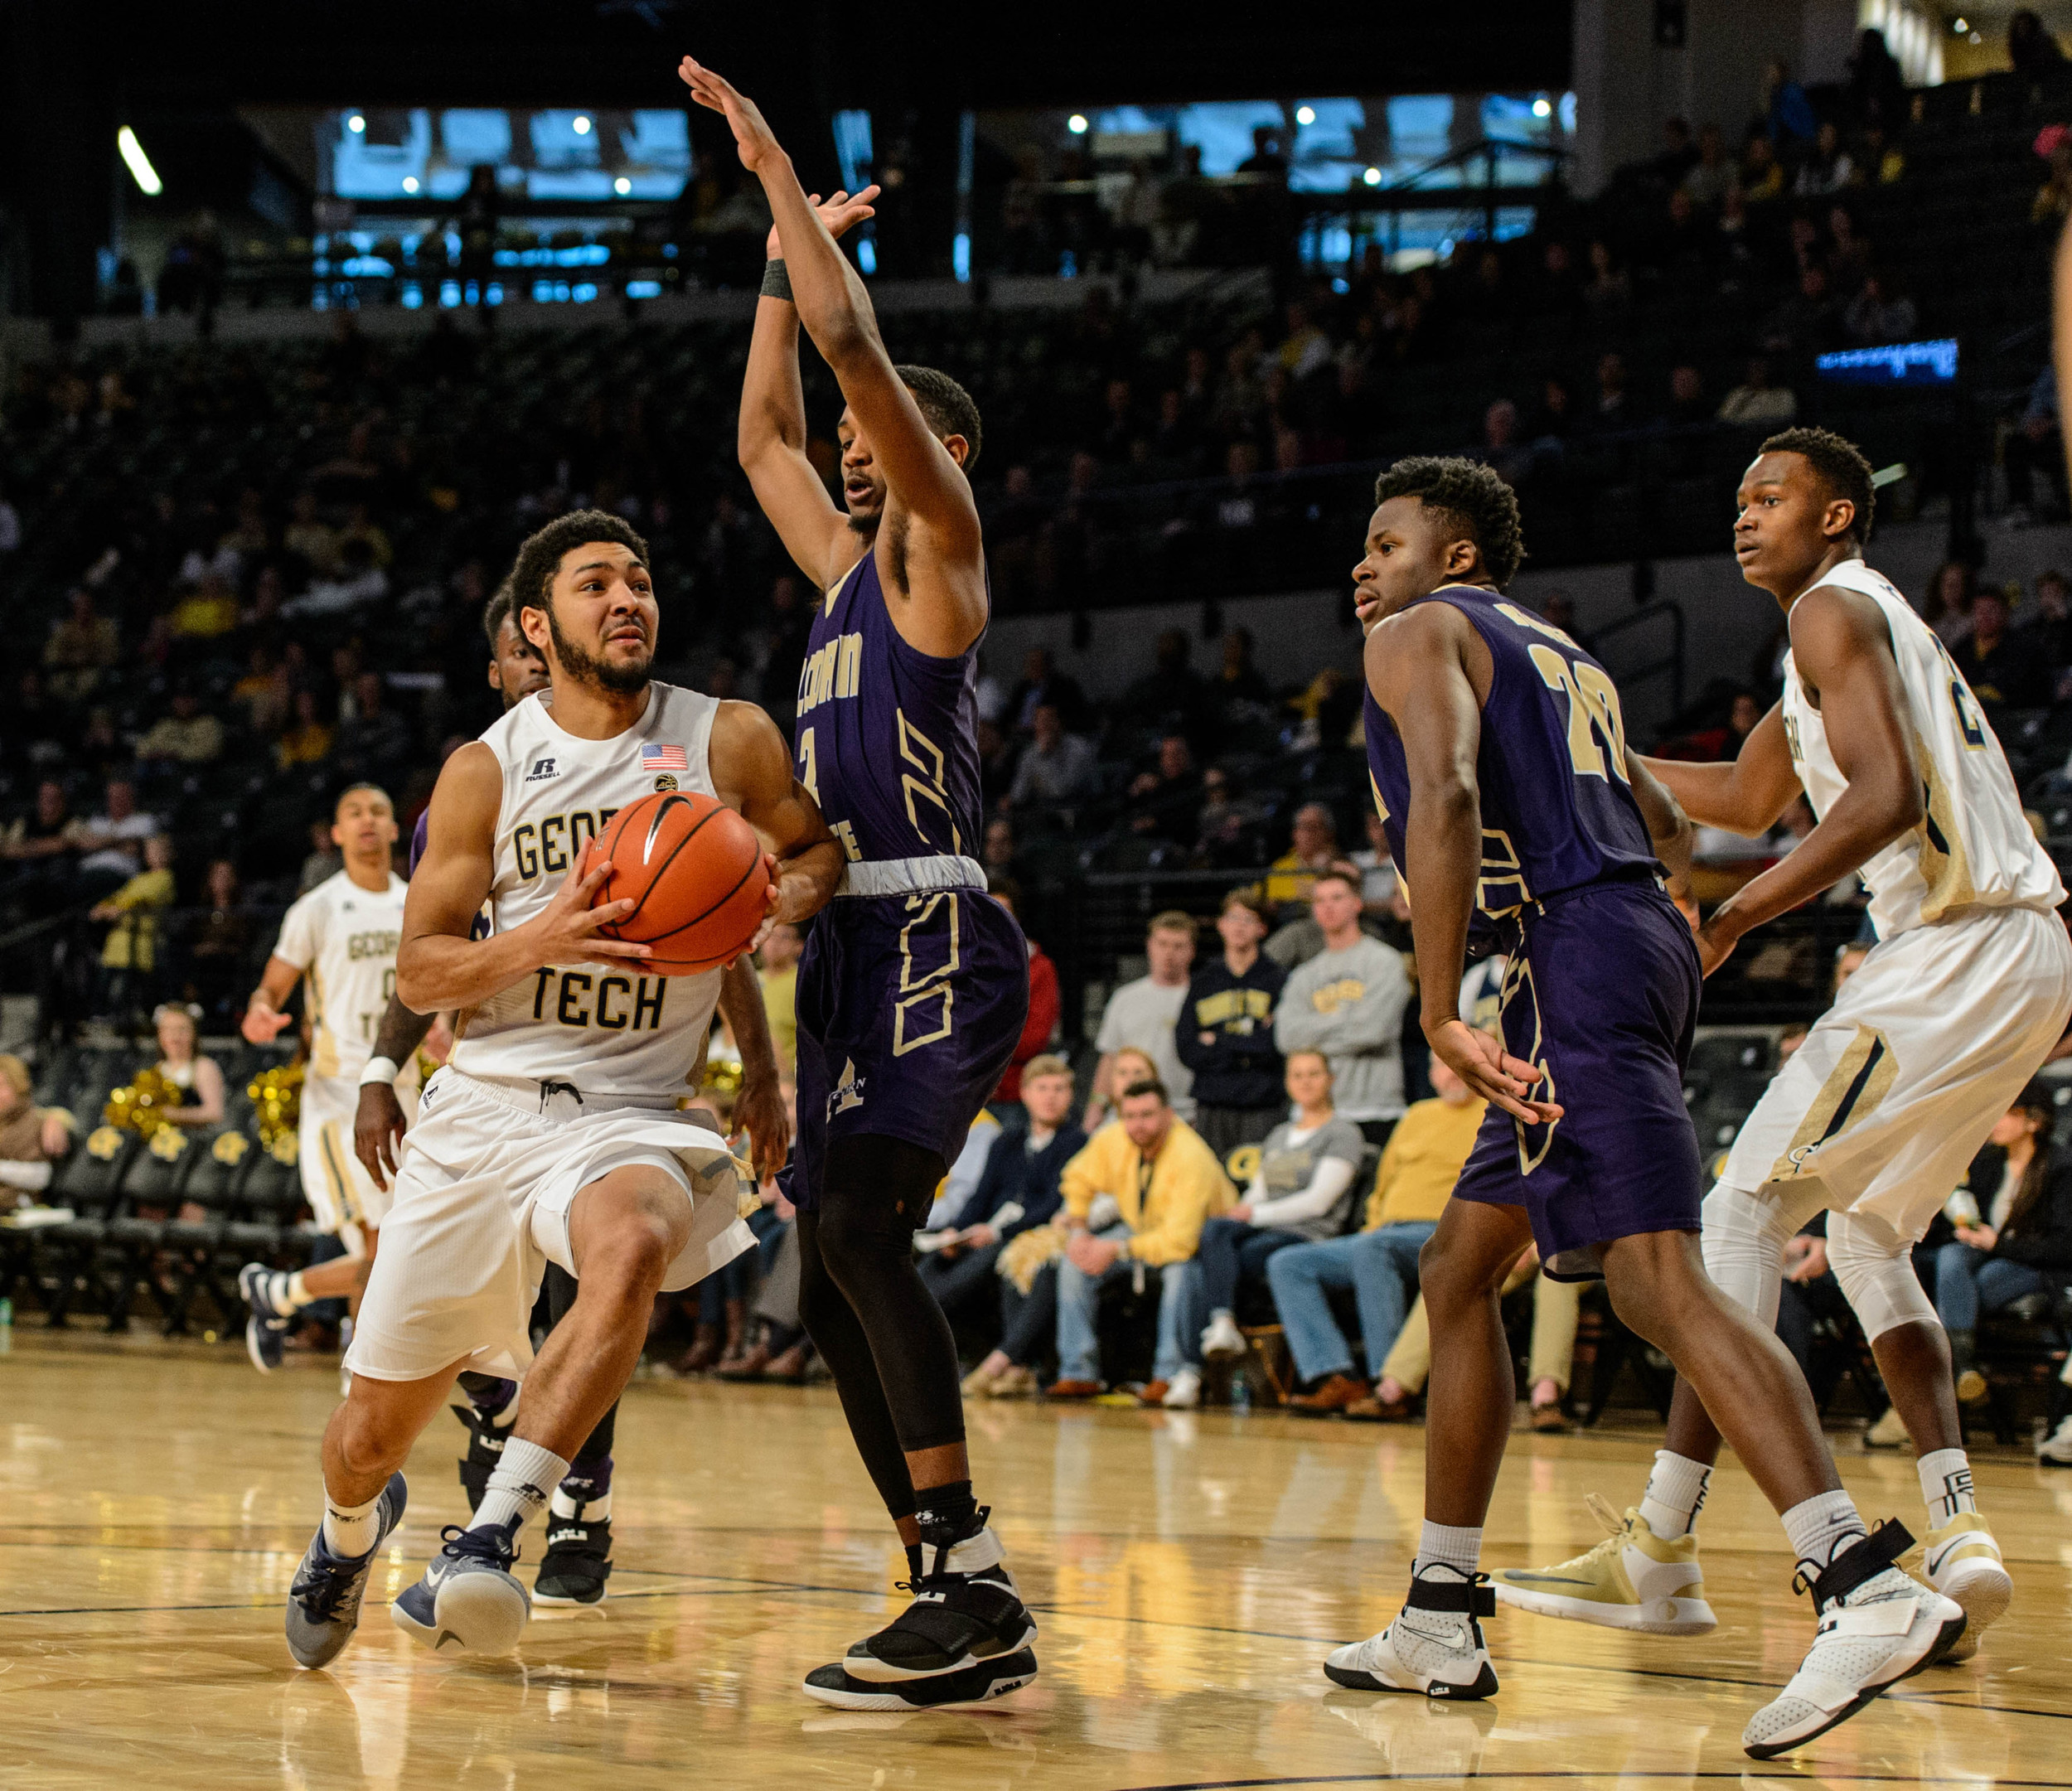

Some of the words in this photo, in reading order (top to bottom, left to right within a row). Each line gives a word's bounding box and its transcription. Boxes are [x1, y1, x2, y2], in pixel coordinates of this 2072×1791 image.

[525, 772, 560, 782] RUSSELL
[513, 808, 621, 881] GEO
[532, 965, 668, 1030] TECH
